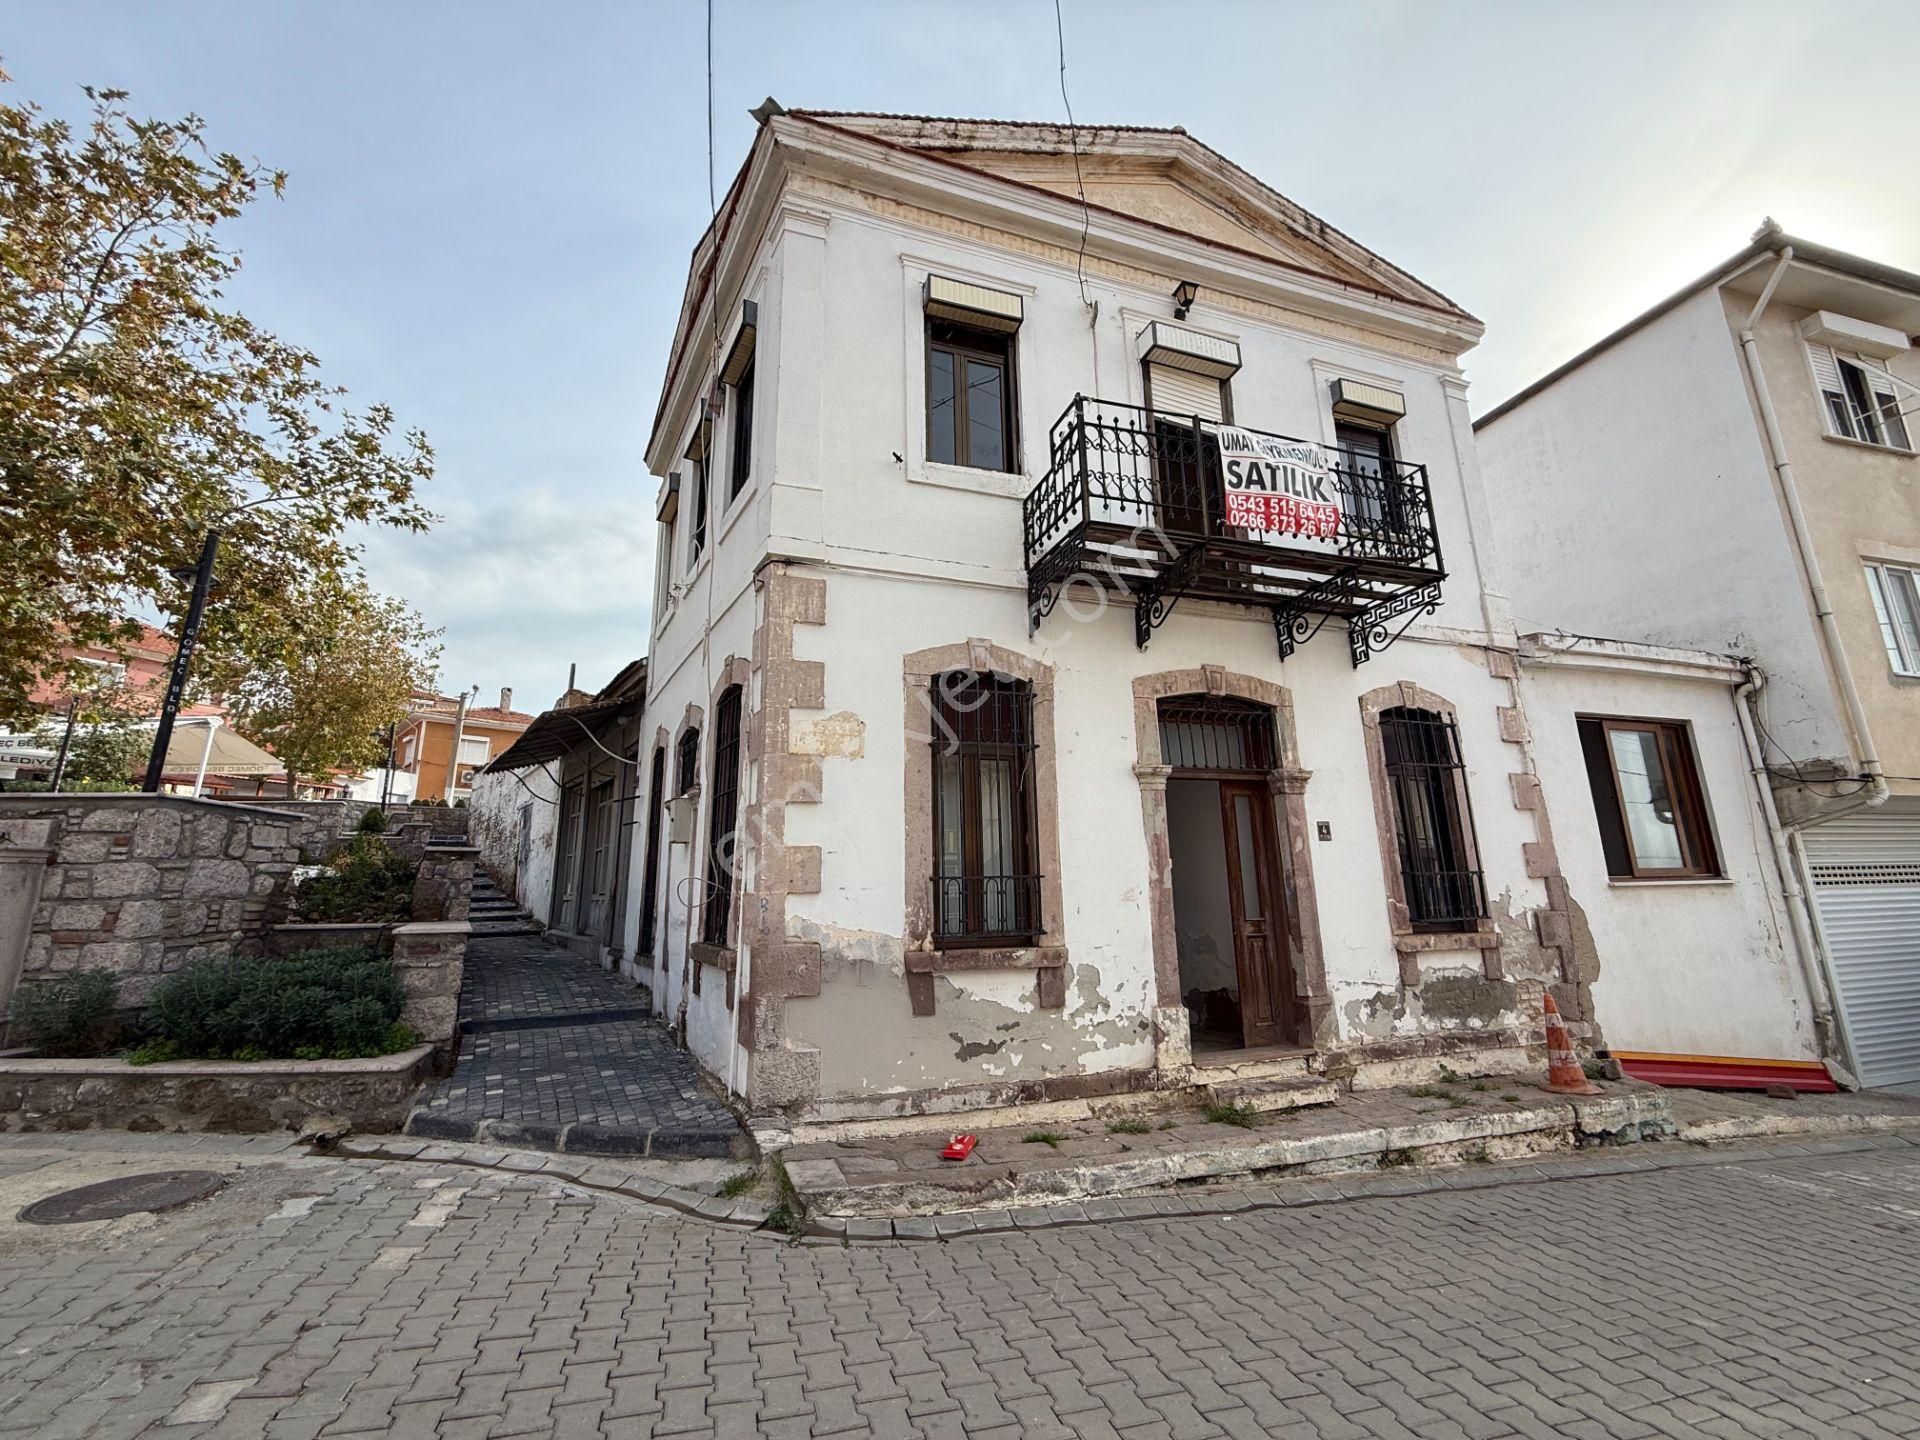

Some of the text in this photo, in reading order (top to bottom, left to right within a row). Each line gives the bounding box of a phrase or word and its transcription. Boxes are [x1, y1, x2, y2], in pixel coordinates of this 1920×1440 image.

[1221, 432, 1254, 452] UMAY
[1227, 459, 1331, 502] SATILIK
[1229, 494, 1335, 522] 0543 515 64 45
[1230, 510, 1335, 537] 0266 373 26 60
